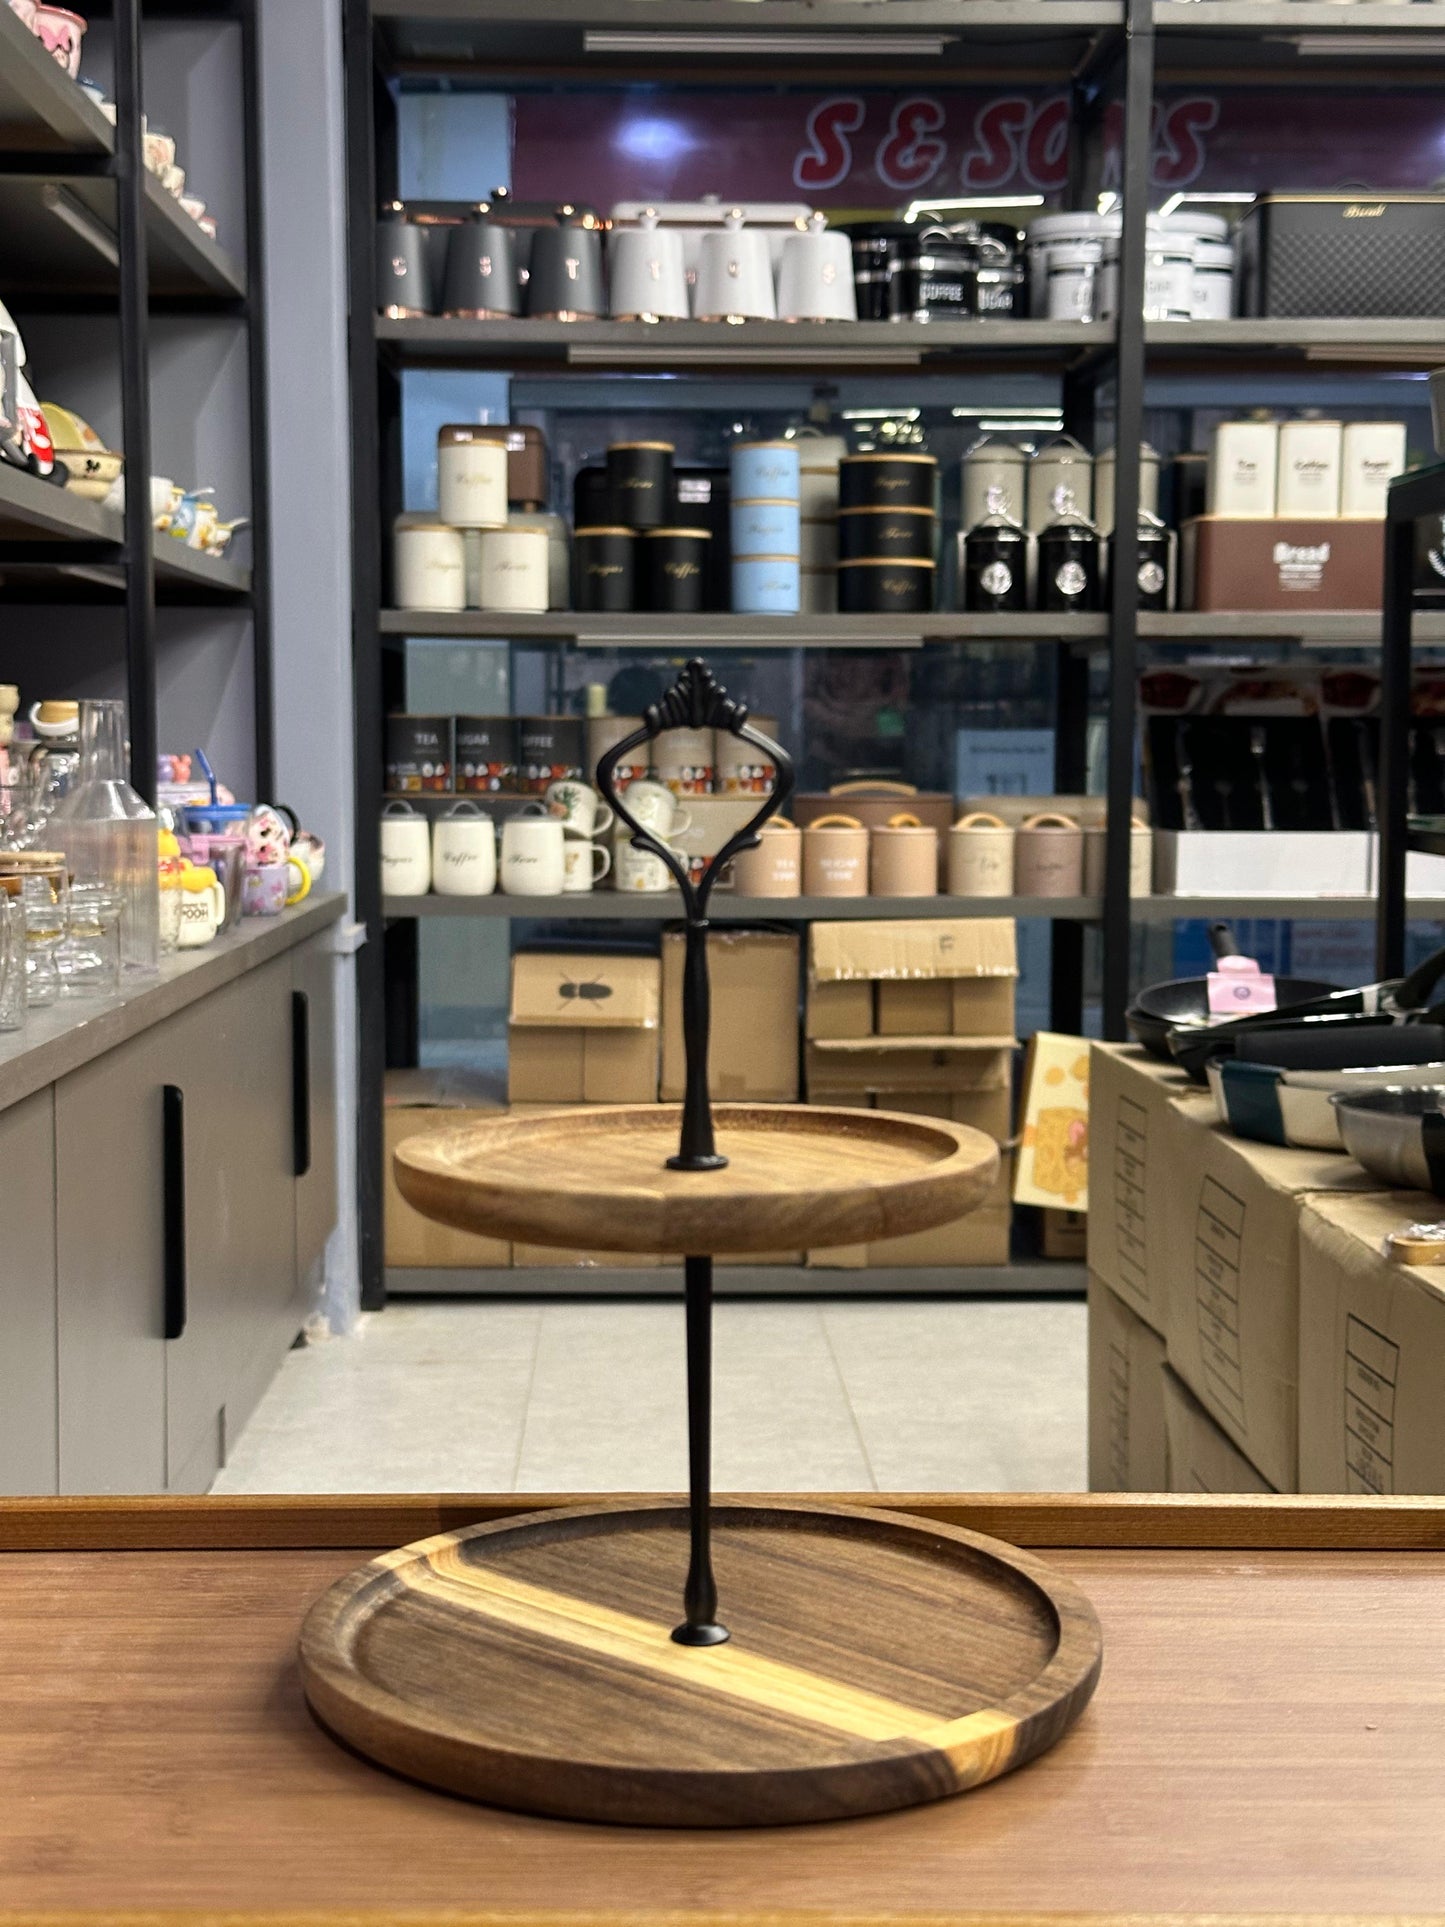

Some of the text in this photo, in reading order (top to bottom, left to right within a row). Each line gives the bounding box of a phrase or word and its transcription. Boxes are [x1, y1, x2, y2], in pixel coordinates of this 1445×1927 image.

[794, 98, 865, 190] S
[876, 97, 947, 190] &
[1273, 541, 1331, 565] Bread
[414, 733, 439, 746] TEA
